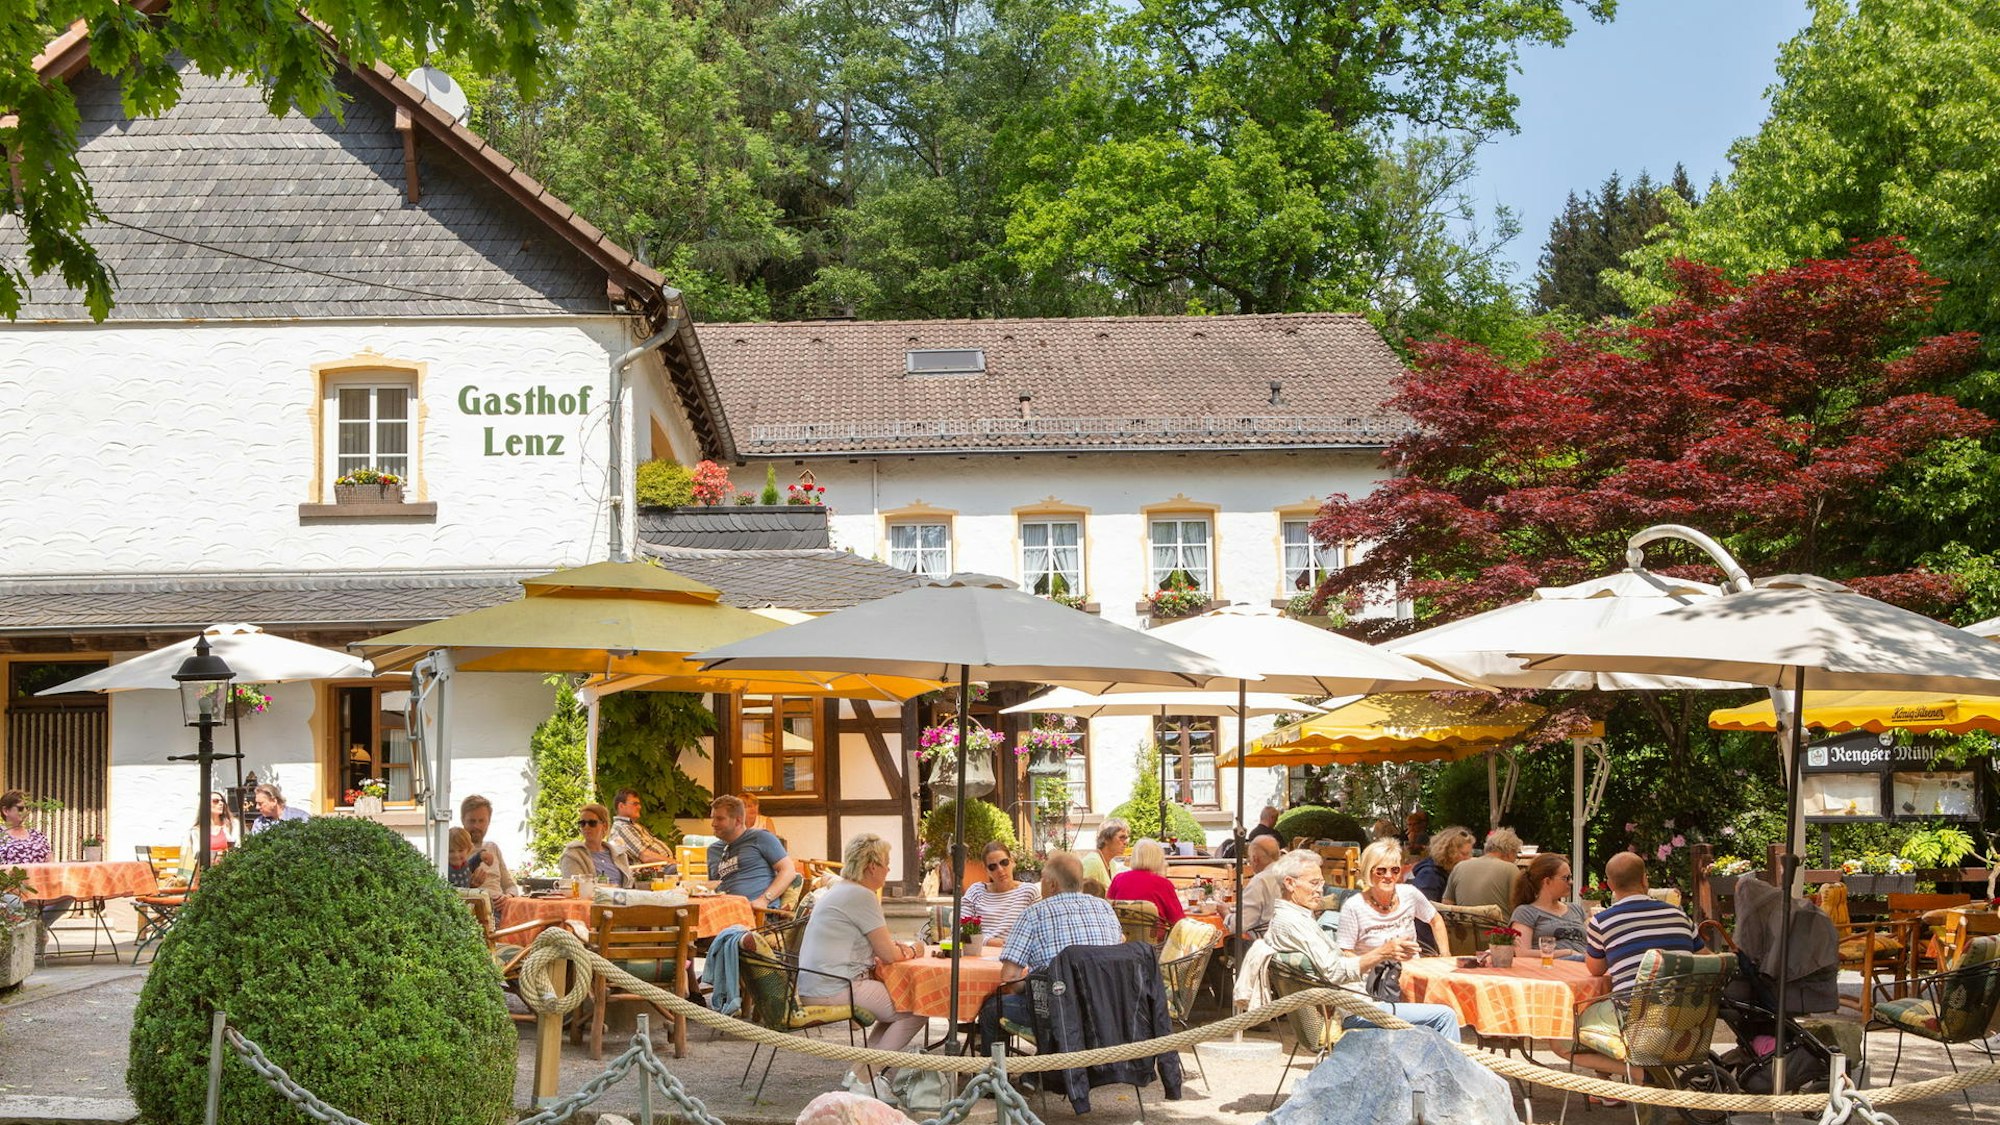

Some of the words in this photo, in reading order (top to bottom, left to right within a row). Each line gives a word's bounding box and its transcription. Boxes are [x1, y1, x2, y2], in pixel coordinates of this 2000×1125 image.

[458, 385, 594, 415] Gasthof
[483, 426, 565, 456] Lenz
[1831, 746, 1892, 766] Rengser
